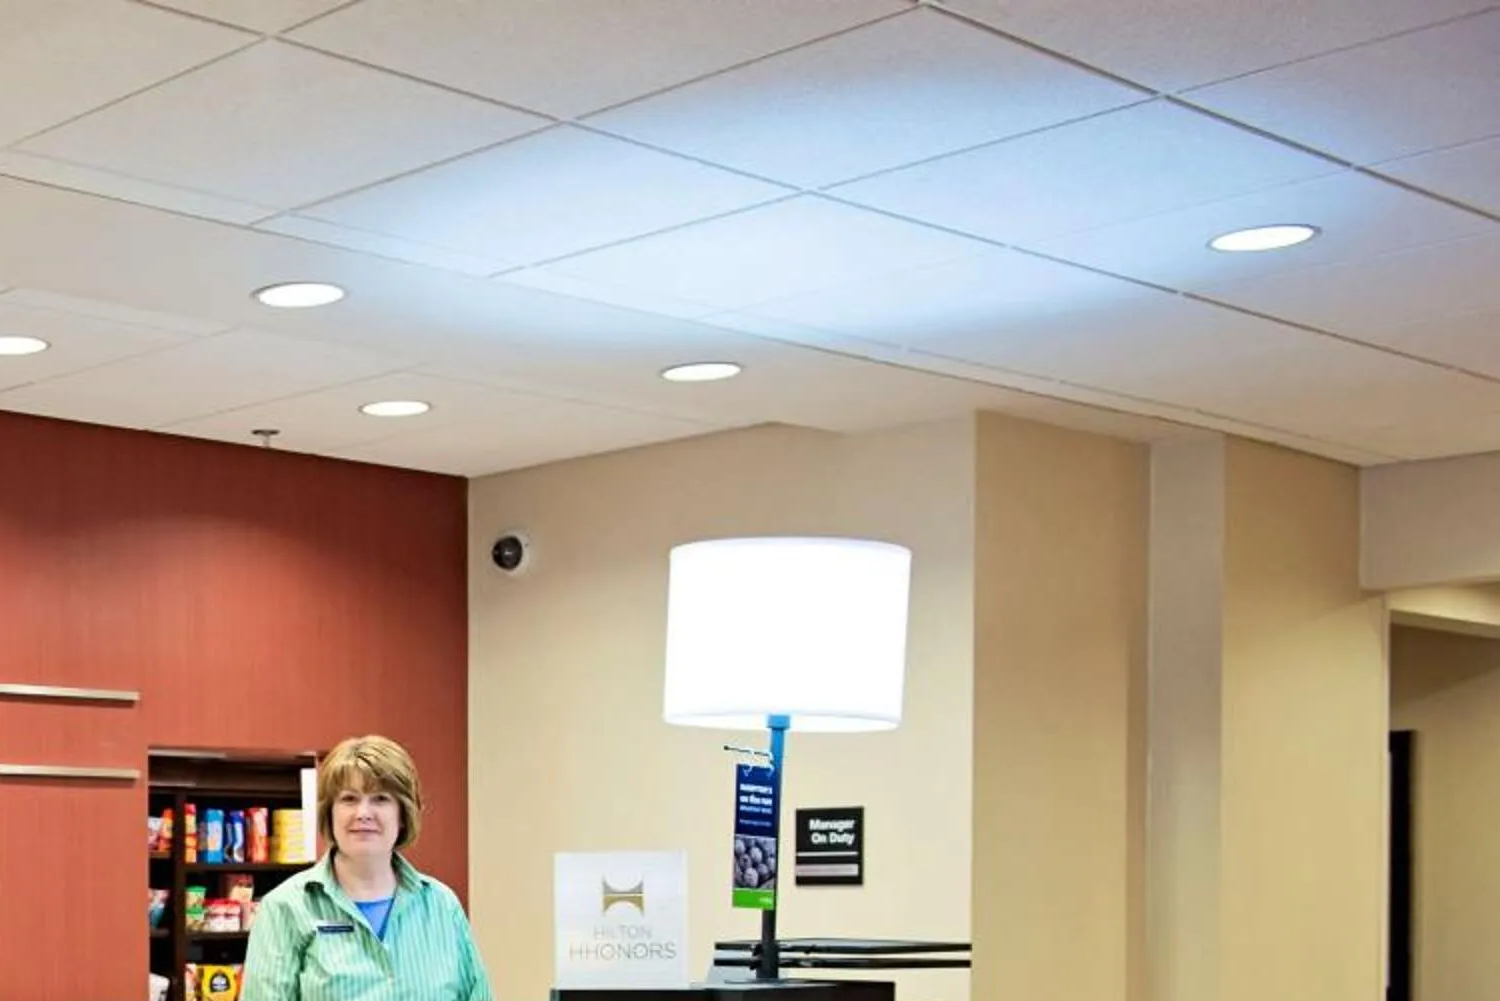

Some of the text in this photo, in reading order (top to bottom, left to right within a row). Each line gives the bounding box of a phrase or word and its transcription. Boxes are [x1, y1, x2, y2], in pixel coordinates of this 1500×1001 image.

[809, 819, 855, 832] Manager
[811, 832, 855, 846] On Duty
[593, 924, 653, 940] HILTON
[569, 941, 677, 960] HHONORS
